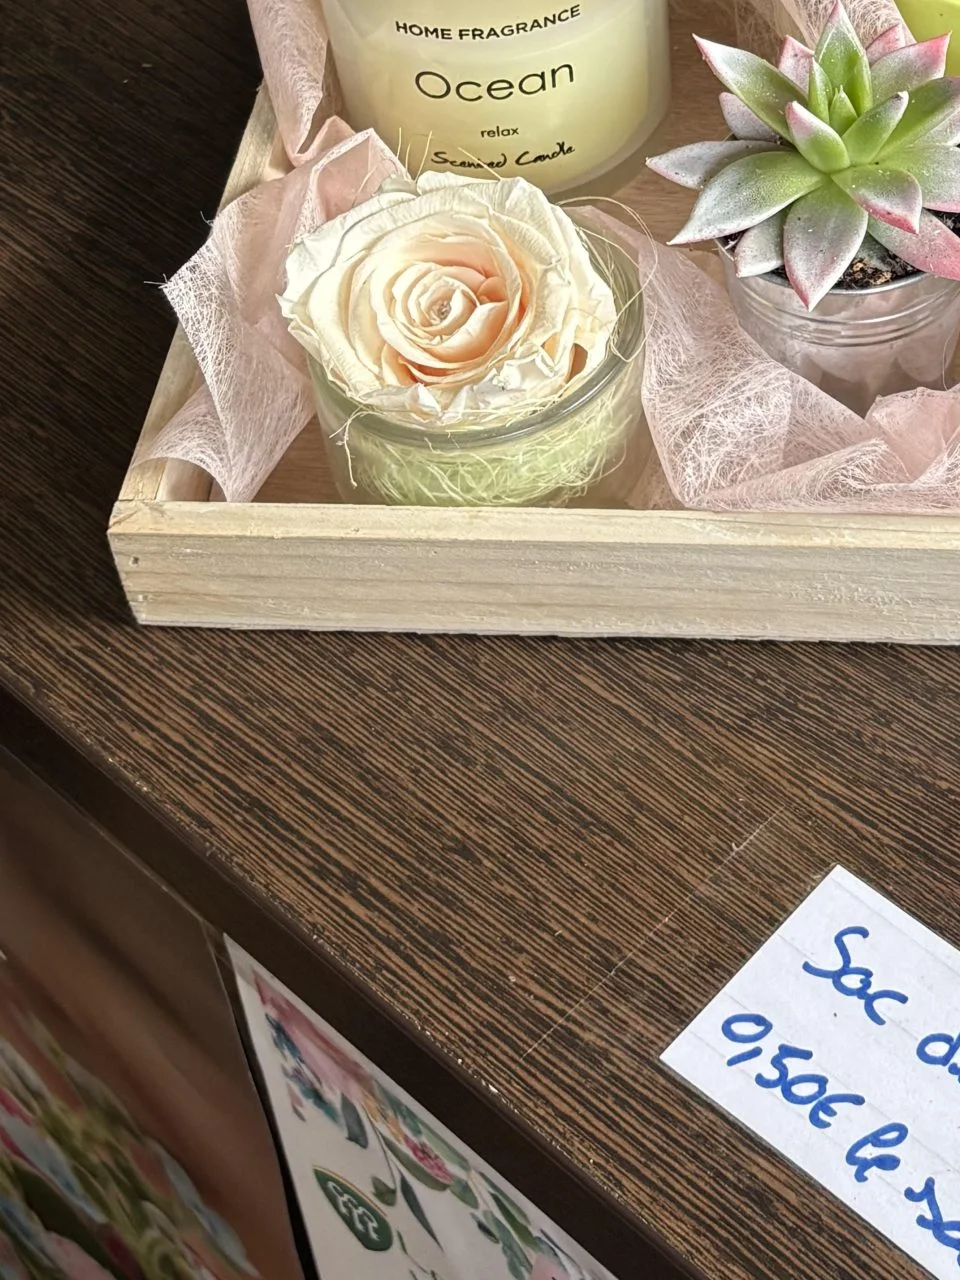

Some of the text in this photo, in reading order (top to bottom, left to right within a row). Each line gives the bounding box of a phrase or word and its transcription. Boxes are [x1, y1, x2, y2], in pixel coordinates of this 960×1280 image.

[395, 4, 581, 41] HOME FRAGRANCE
[414, 63, 575, 101] Ocean
[480, 125, 519, 139] relax
[515, 140, 576, 167] Candle
[802, 927, 908, 1026] Sac
[721, 1013, 865, 1130] 0,50€
[845, 1122, 908, 1183] le
